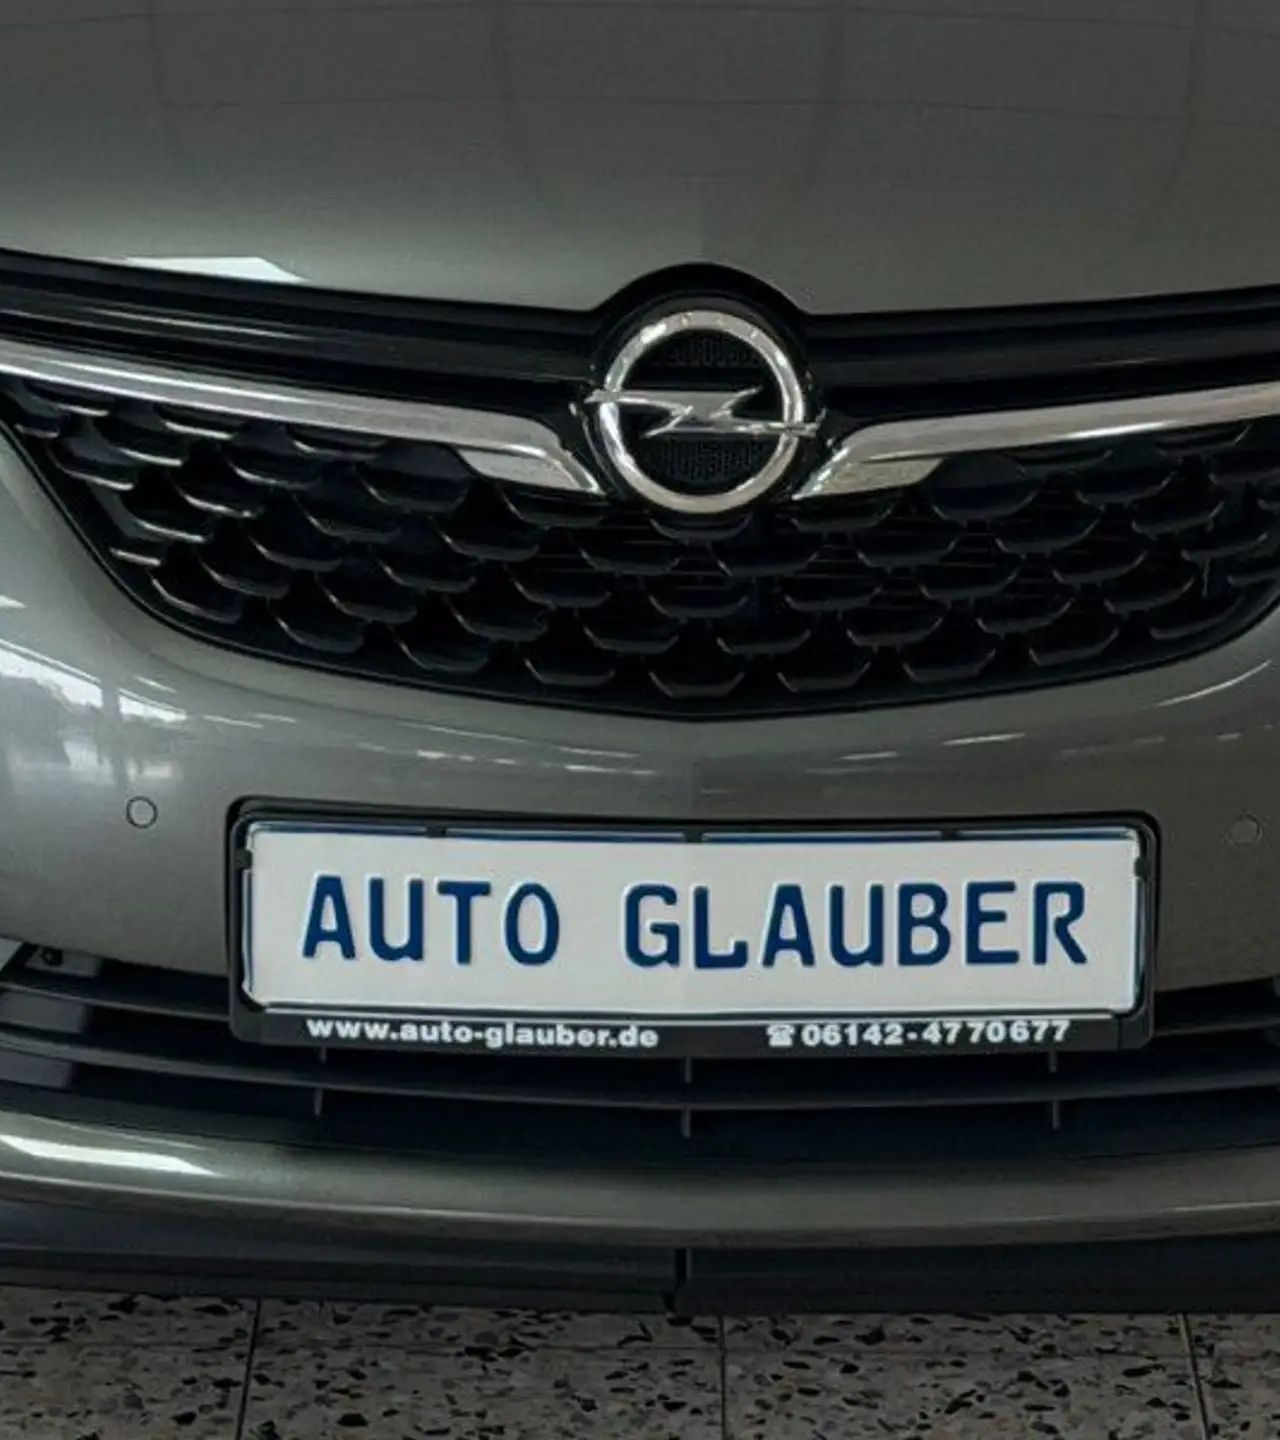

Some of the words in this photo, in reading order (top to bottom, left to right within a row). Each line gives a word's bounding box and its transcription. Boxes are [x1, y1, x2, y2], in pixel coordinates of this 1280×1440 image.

[302, 873, 561, 967] AUTO
[623, 879, 1088, 970] GLAUBER
[305, 1018, 659, 1049] www.auto-glauber.de
[801, 1020, 1070, 1047] 06142-4770677
